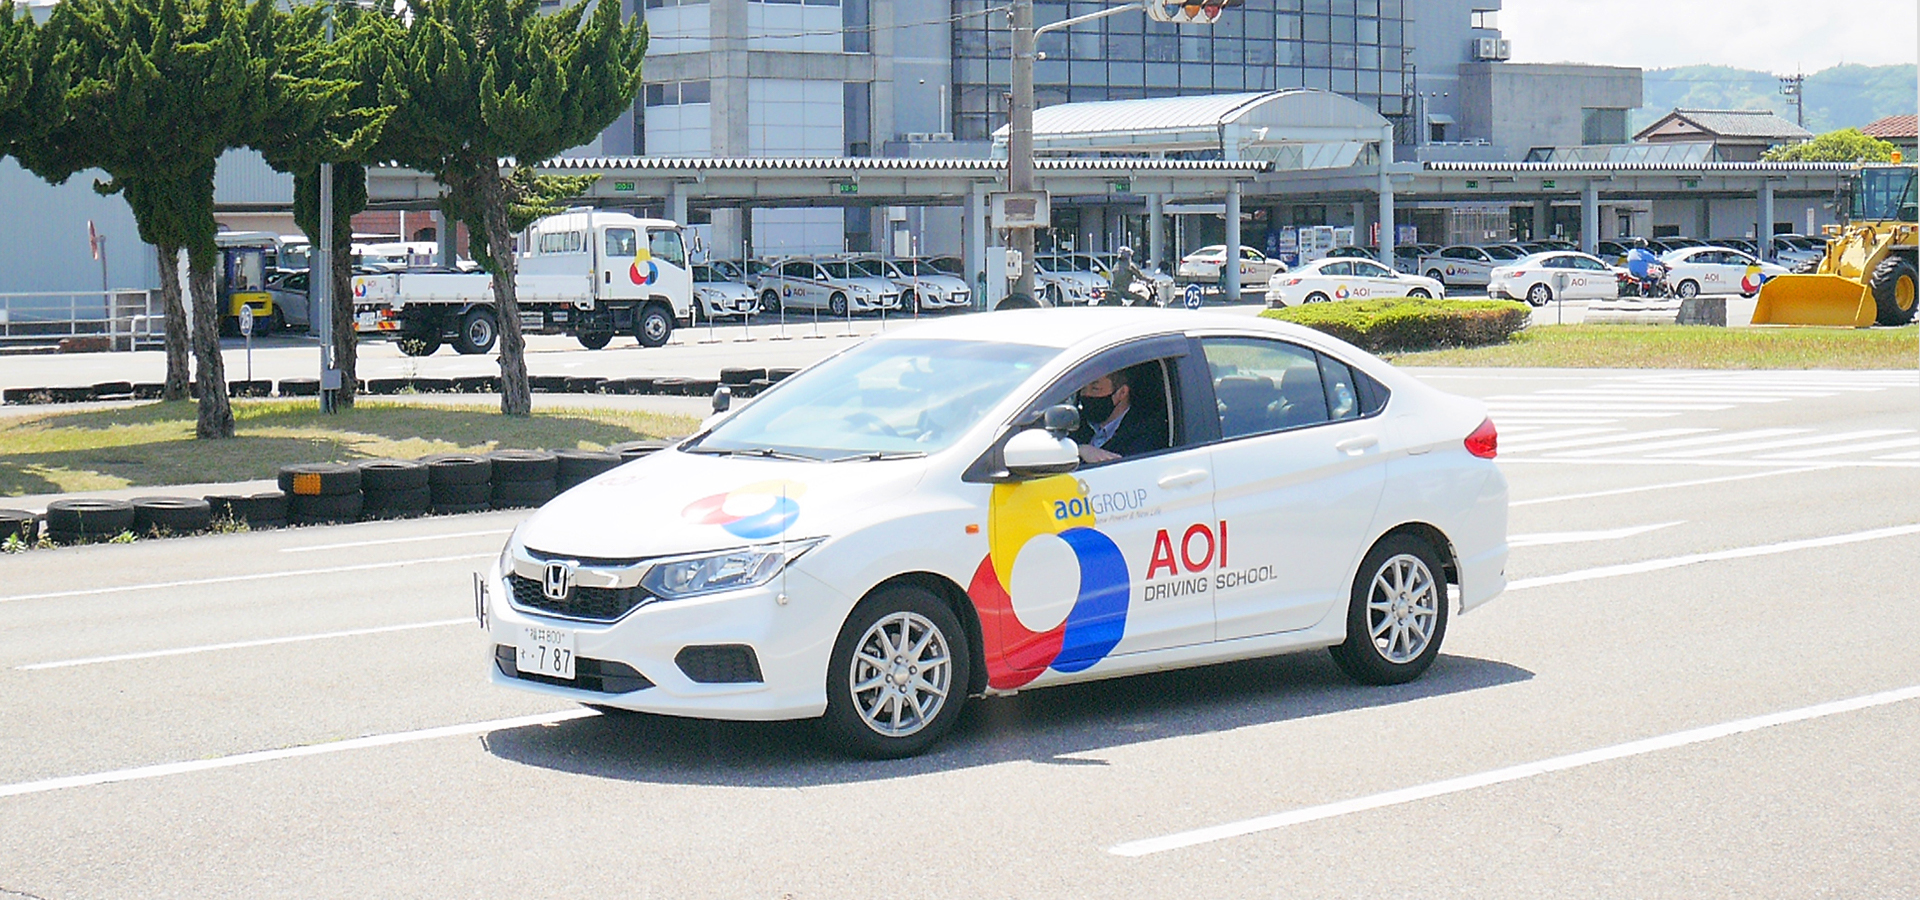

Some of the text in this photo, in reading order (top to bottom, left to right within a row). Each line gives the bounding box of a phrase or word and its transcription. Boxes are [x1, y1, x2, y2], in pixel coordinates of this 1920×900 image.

[1571, 278, 1587, 286] AOI
[1704, 273, 1720, 281] AOI
[793, 288, 806, 297] AOI
[1353, 287, 1371, 297] AOI
[1187, 289, 1200, 307] 25
[1146, 520, 1228, 580] AOI
[1144, 564, 1278, 602] DRIVING SCHOOL
